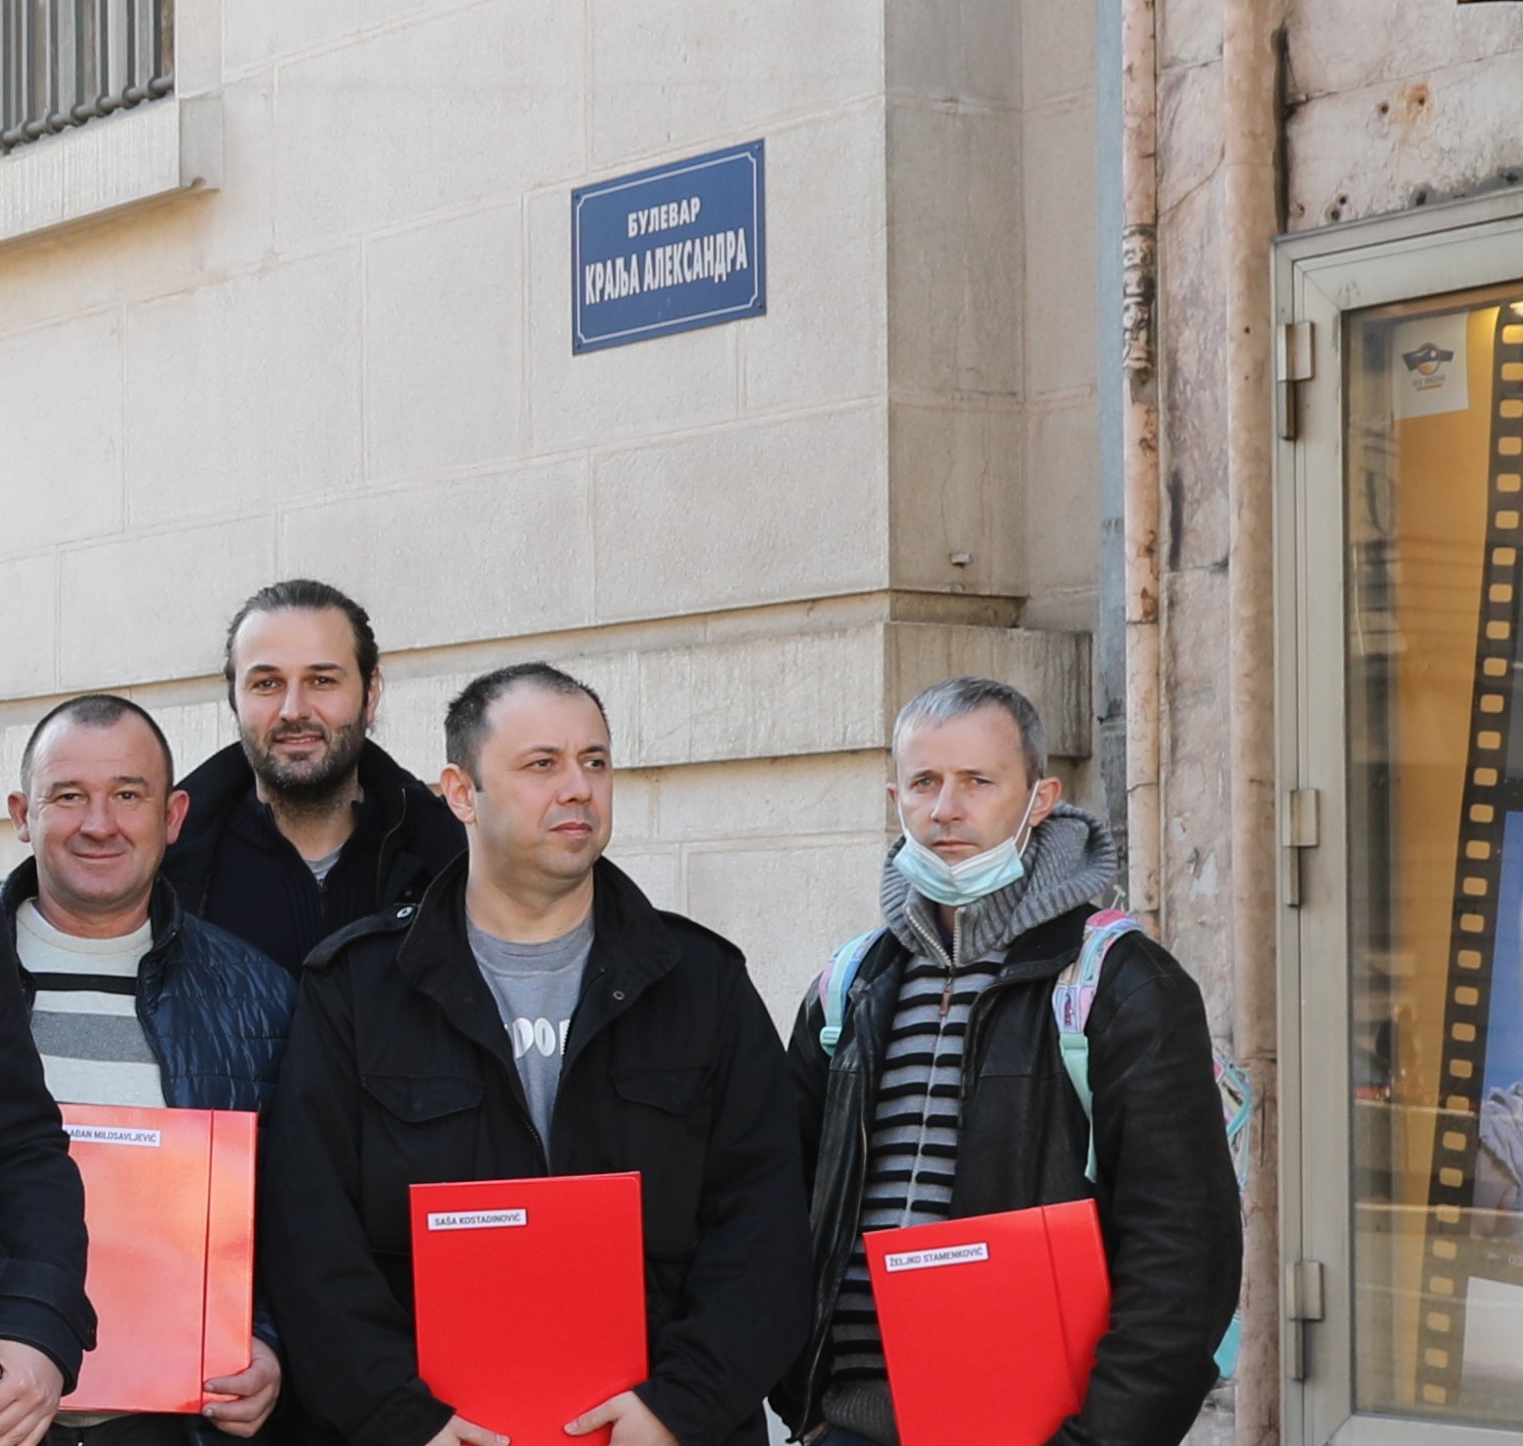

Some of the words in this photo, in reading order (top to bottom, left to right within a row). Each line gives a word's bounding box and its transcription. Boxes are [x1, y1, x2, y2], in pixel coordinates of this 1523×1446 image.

[627, 197, 701, 238] БУЛЕВАР
[585, 253, 640, 305] КРАЉА
[643, 227, 748, 293] АЛЕКСАНДРА
